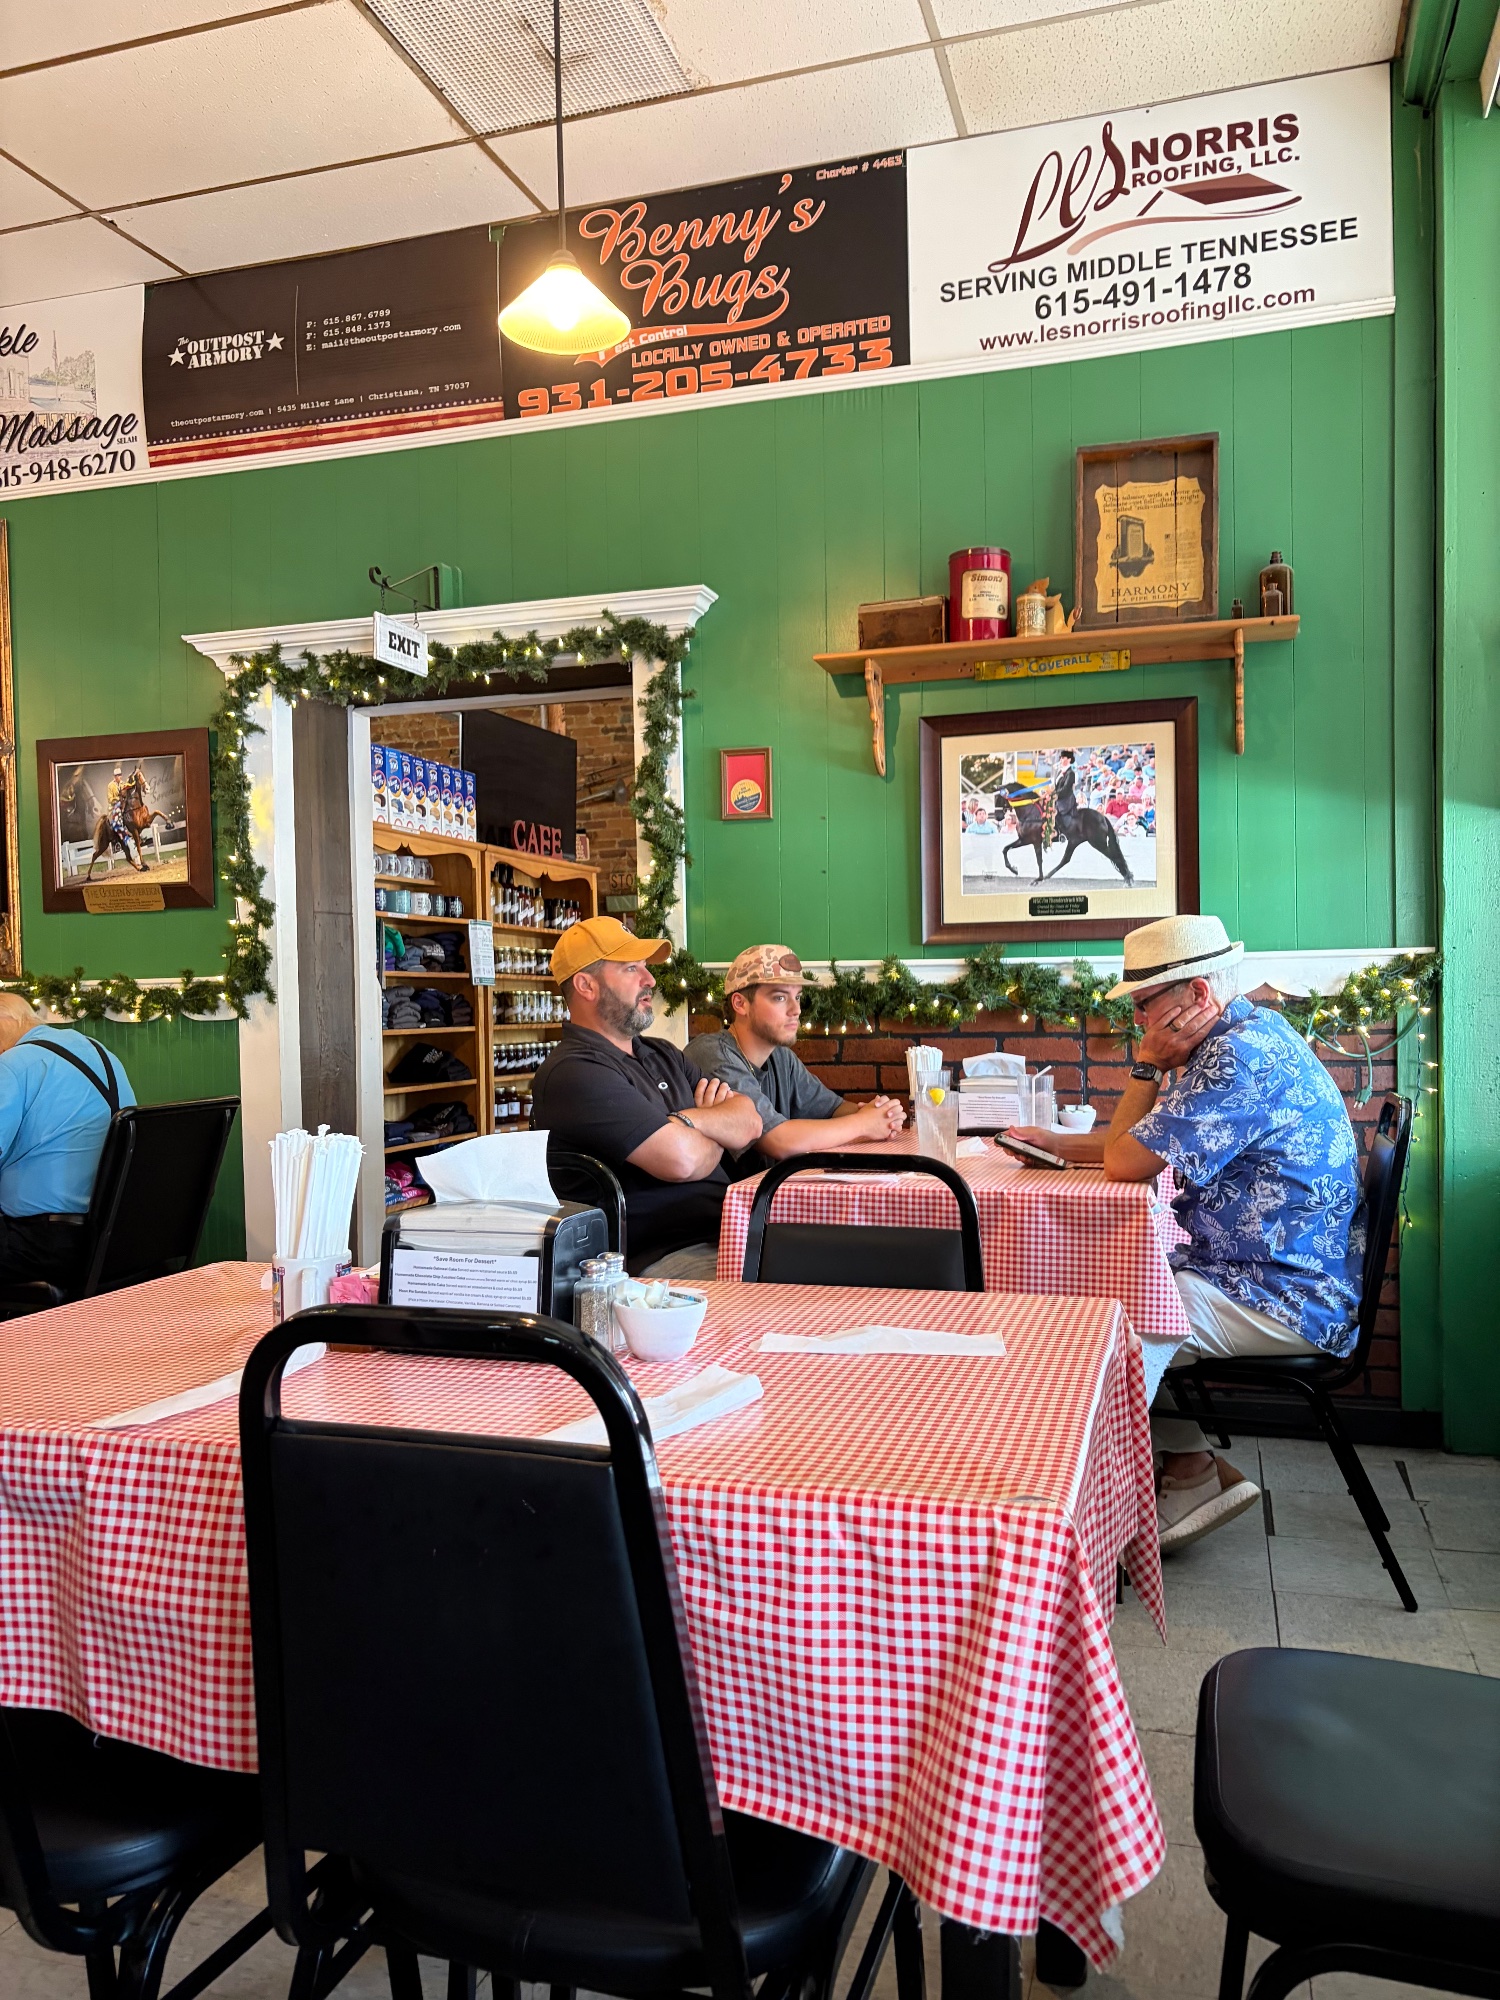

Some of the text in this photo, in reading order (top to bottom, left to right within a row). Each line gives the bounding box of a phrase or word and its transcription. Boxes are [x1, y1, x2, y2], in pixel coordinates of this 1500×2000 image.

[1131, 112, 1300, 169] NORRIS
[815, 155, 903, 181] Charter # 4463
[1131, 147, 1301, 188] ROOFING, LLC.
[579, 173, 826, 265] Benny's
[939, 216, 1359, 303] SERVING MIDDLE TENNESSEE
[620, 253, 791, 325] Bugs
[1034, 262, 1253, 320] 615-491-1478
[322, 308, 392, 326] 615.867.6789
[322, 319, 392, 338] 615.848.1373
[978, 286, 1316, 351] www.lesnorrisroofingllc.com
[177, 336, 190, 347] The
[186, 330, 265, 355] OUTPOST
[321, 322, 462, 350] mail@theoutpostarmory.com
[631, 315, 892, 368] LOCALLY OWNED & OPERATED
[639, 324, 688, 346] Control
[187, 345, 264, 369] ARMORY
[518, 337, 894, 418] 931-205-4733
[170, 380, 471, 428] theoutpostarmory.com 5435 Miller Lane Christiana, TN 37037
[0, 411, 139, 455] Massage
[0, 448, 137, 488] 15-948-6270
[1110, 582, 1191, 599] HARMONY
[1130, 594, 1149, 602] PIPE
[388, 630, 421, 660] EXIT
[1027, 654, 1093, 674] COVERALL
[513, 819, 563, 859] CAFE
[611, 873, 637, 889] STO
